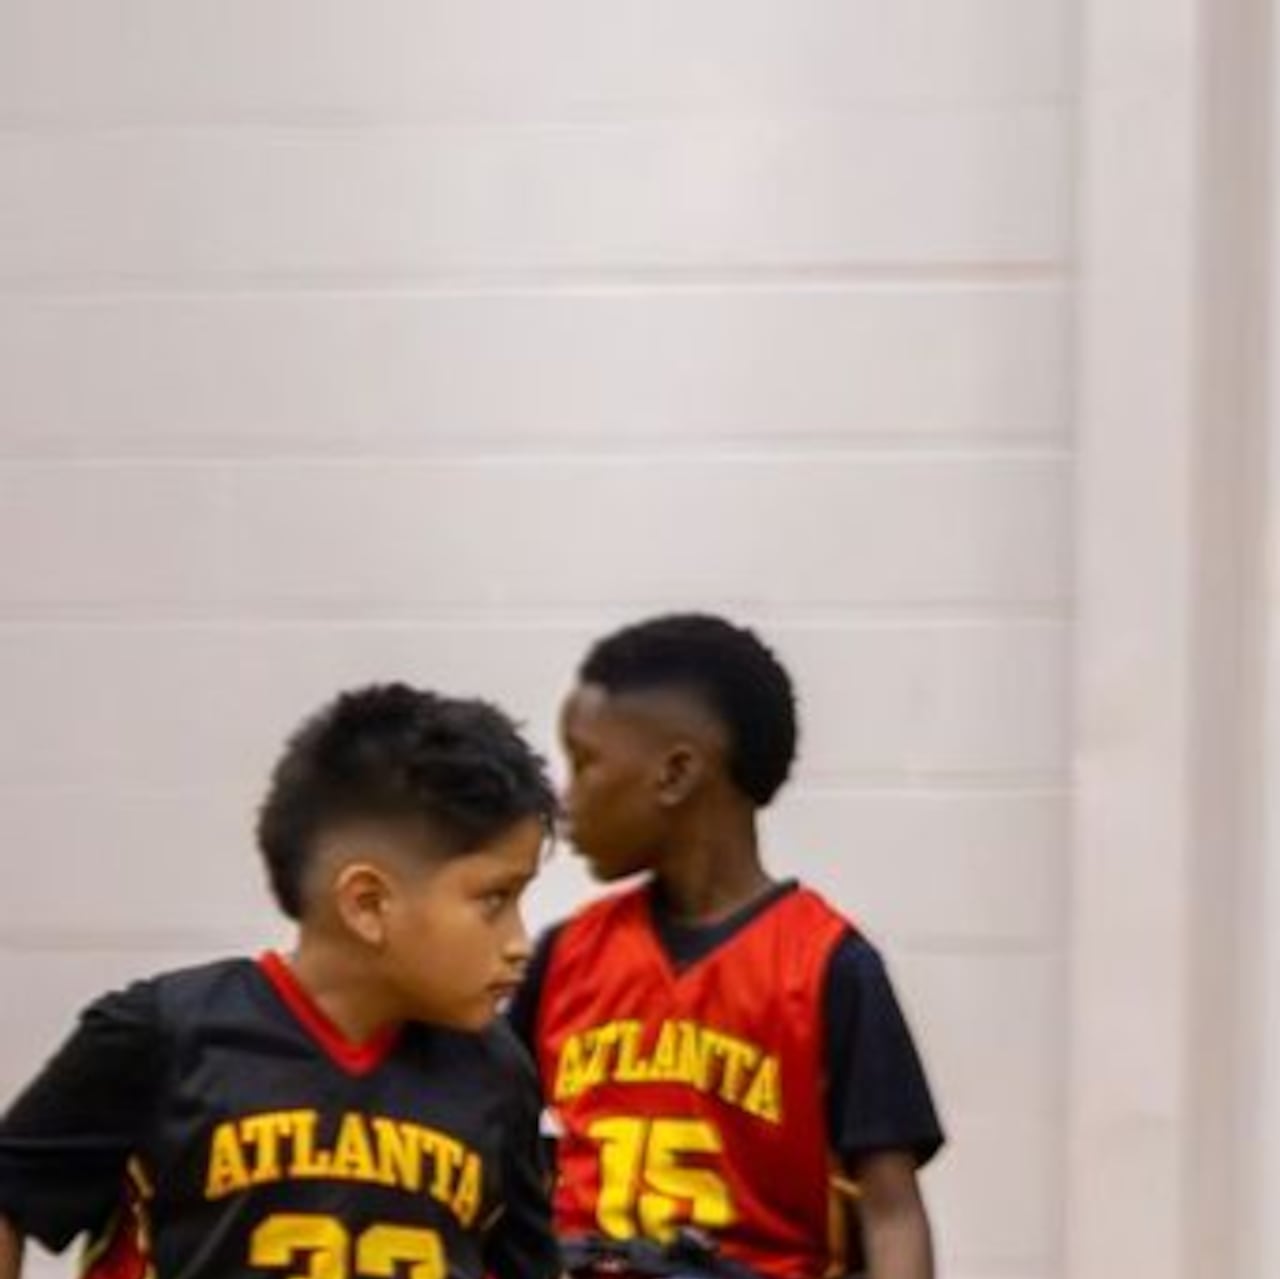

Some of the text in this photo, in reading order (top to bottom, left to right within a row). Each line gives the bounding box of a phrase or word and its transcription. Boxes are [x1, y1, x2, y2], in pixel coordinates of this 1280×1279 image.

[554, 1019, 782, 1124] ATLANTA
[205, 1108, 482, 1229] ATLANTA
[587, 1115, 735, 1245] 15
